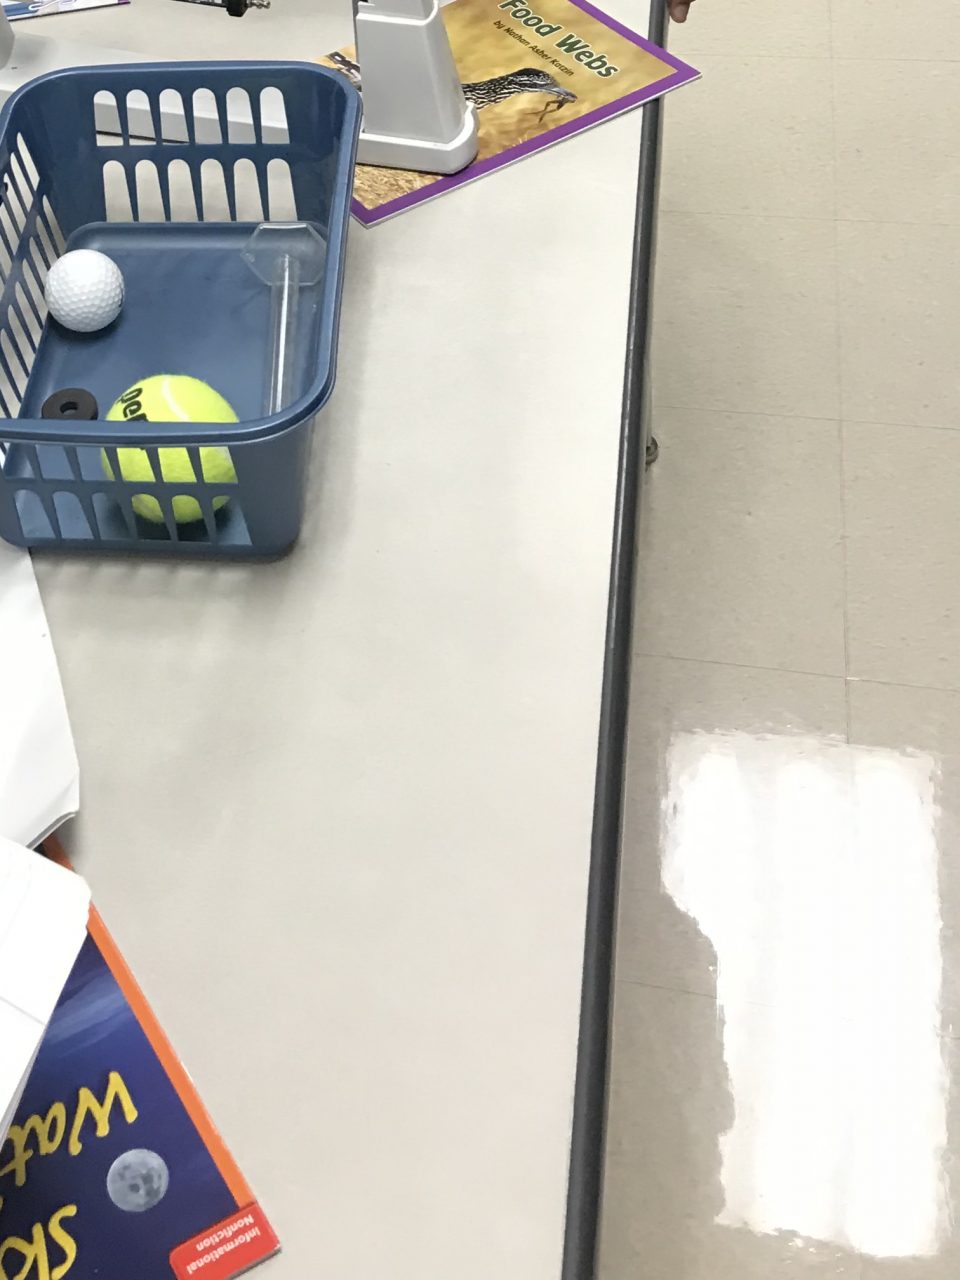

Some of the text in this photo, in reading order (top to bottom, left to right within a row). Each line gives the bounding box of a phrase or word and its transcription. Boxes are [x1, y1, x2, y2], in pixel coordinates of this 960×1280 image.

[493, 20, 574, 76] by Nathan Asher Katzin
[555, 33, 618, 77] Webs
[187, 1226, 262, 1275] Informational
[195, 1214, 255, 1252] Nonfiction
